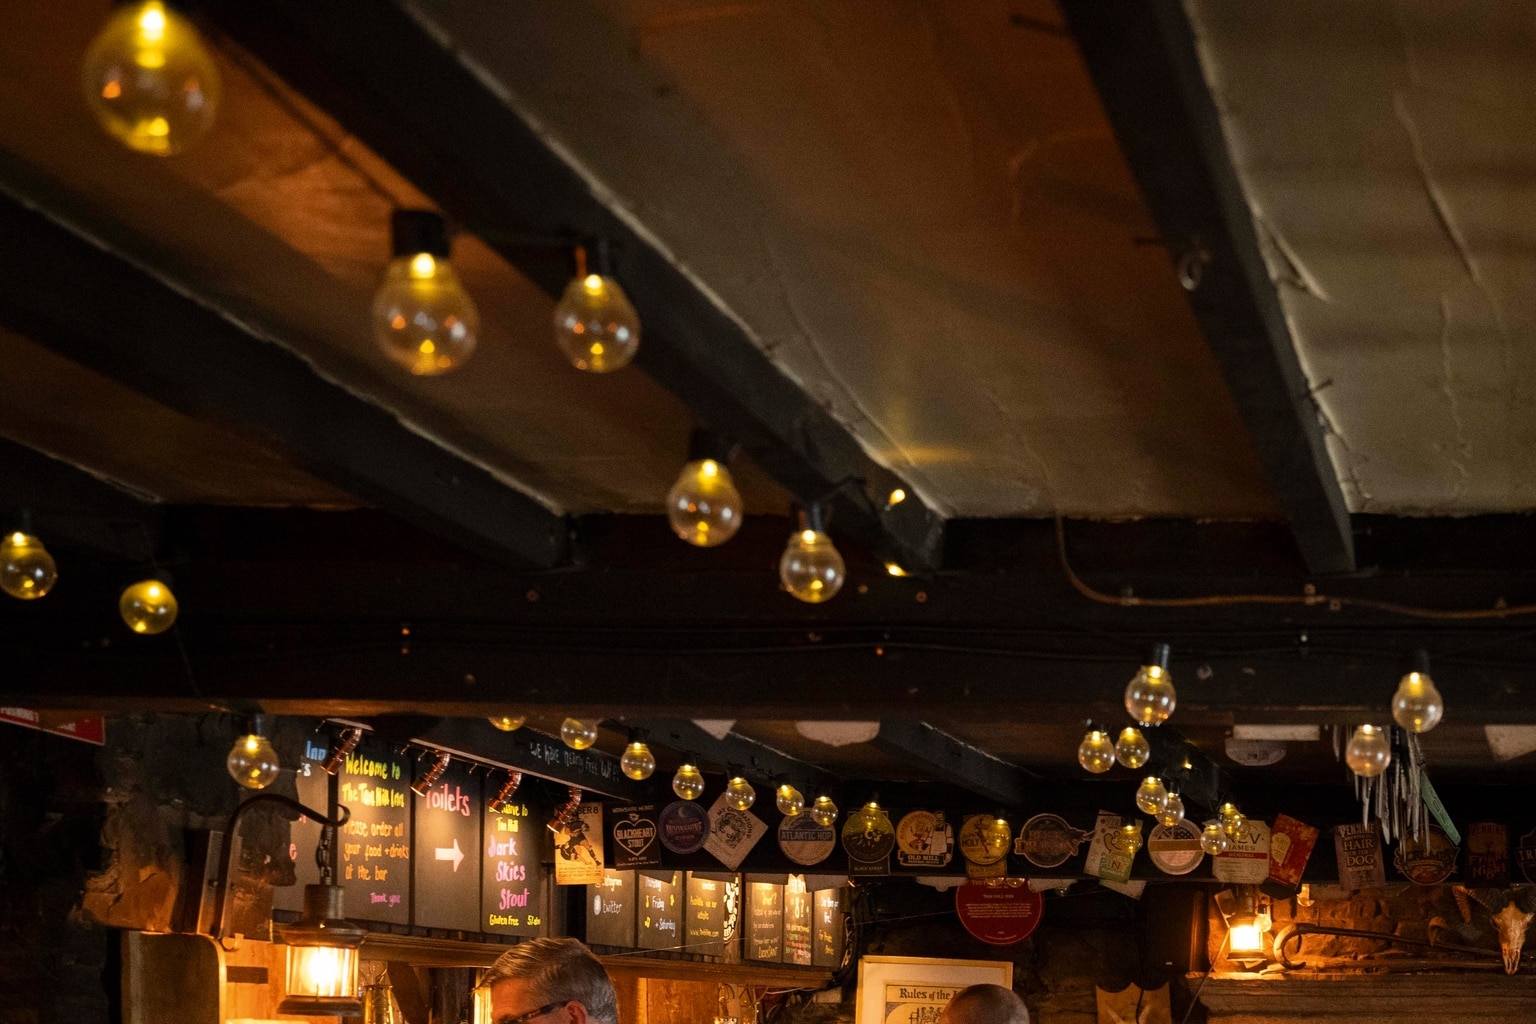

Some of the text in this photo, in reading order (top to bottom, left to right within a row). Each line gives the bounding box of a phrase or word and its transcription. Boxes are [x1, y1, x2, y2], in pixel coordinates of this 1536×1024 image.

[345, 755, 401, 781] Welcome to
[341, 783, 358, 803] The
[371, 822, 391, 838] order
[616, 826, 654, 841] BLACKHEART
[781, 830, 832, 842] ATLANTIC HOP
[487, 837, 518, 859] Dark
[627, 838, 645, 849] STOUT
[1228, 844, 1257, 852] JAMES
[1343, 838, 1374, 851] HAIR
[344, 844, 361, 862] your
[365, 844, 383, 862] food
[907, 854, 939, 862] OLD MILL
[1346, 855, 1375, 868] DOG
[345, 863, 389, 882] at the bar
[495, 862, 527, 883] Skies
[370, 892, 401, 908] Thank you
[499, 888, 531, 911] Stout
[651, 895, 666, 912] Friday
[602, 900, 623, 915] twitter
[508, 914, 520, 928] Free
[899, 987, 927, 1000] Rules
[928, 991, 936, 1001] of
[936, 988, 951, 1001] the
